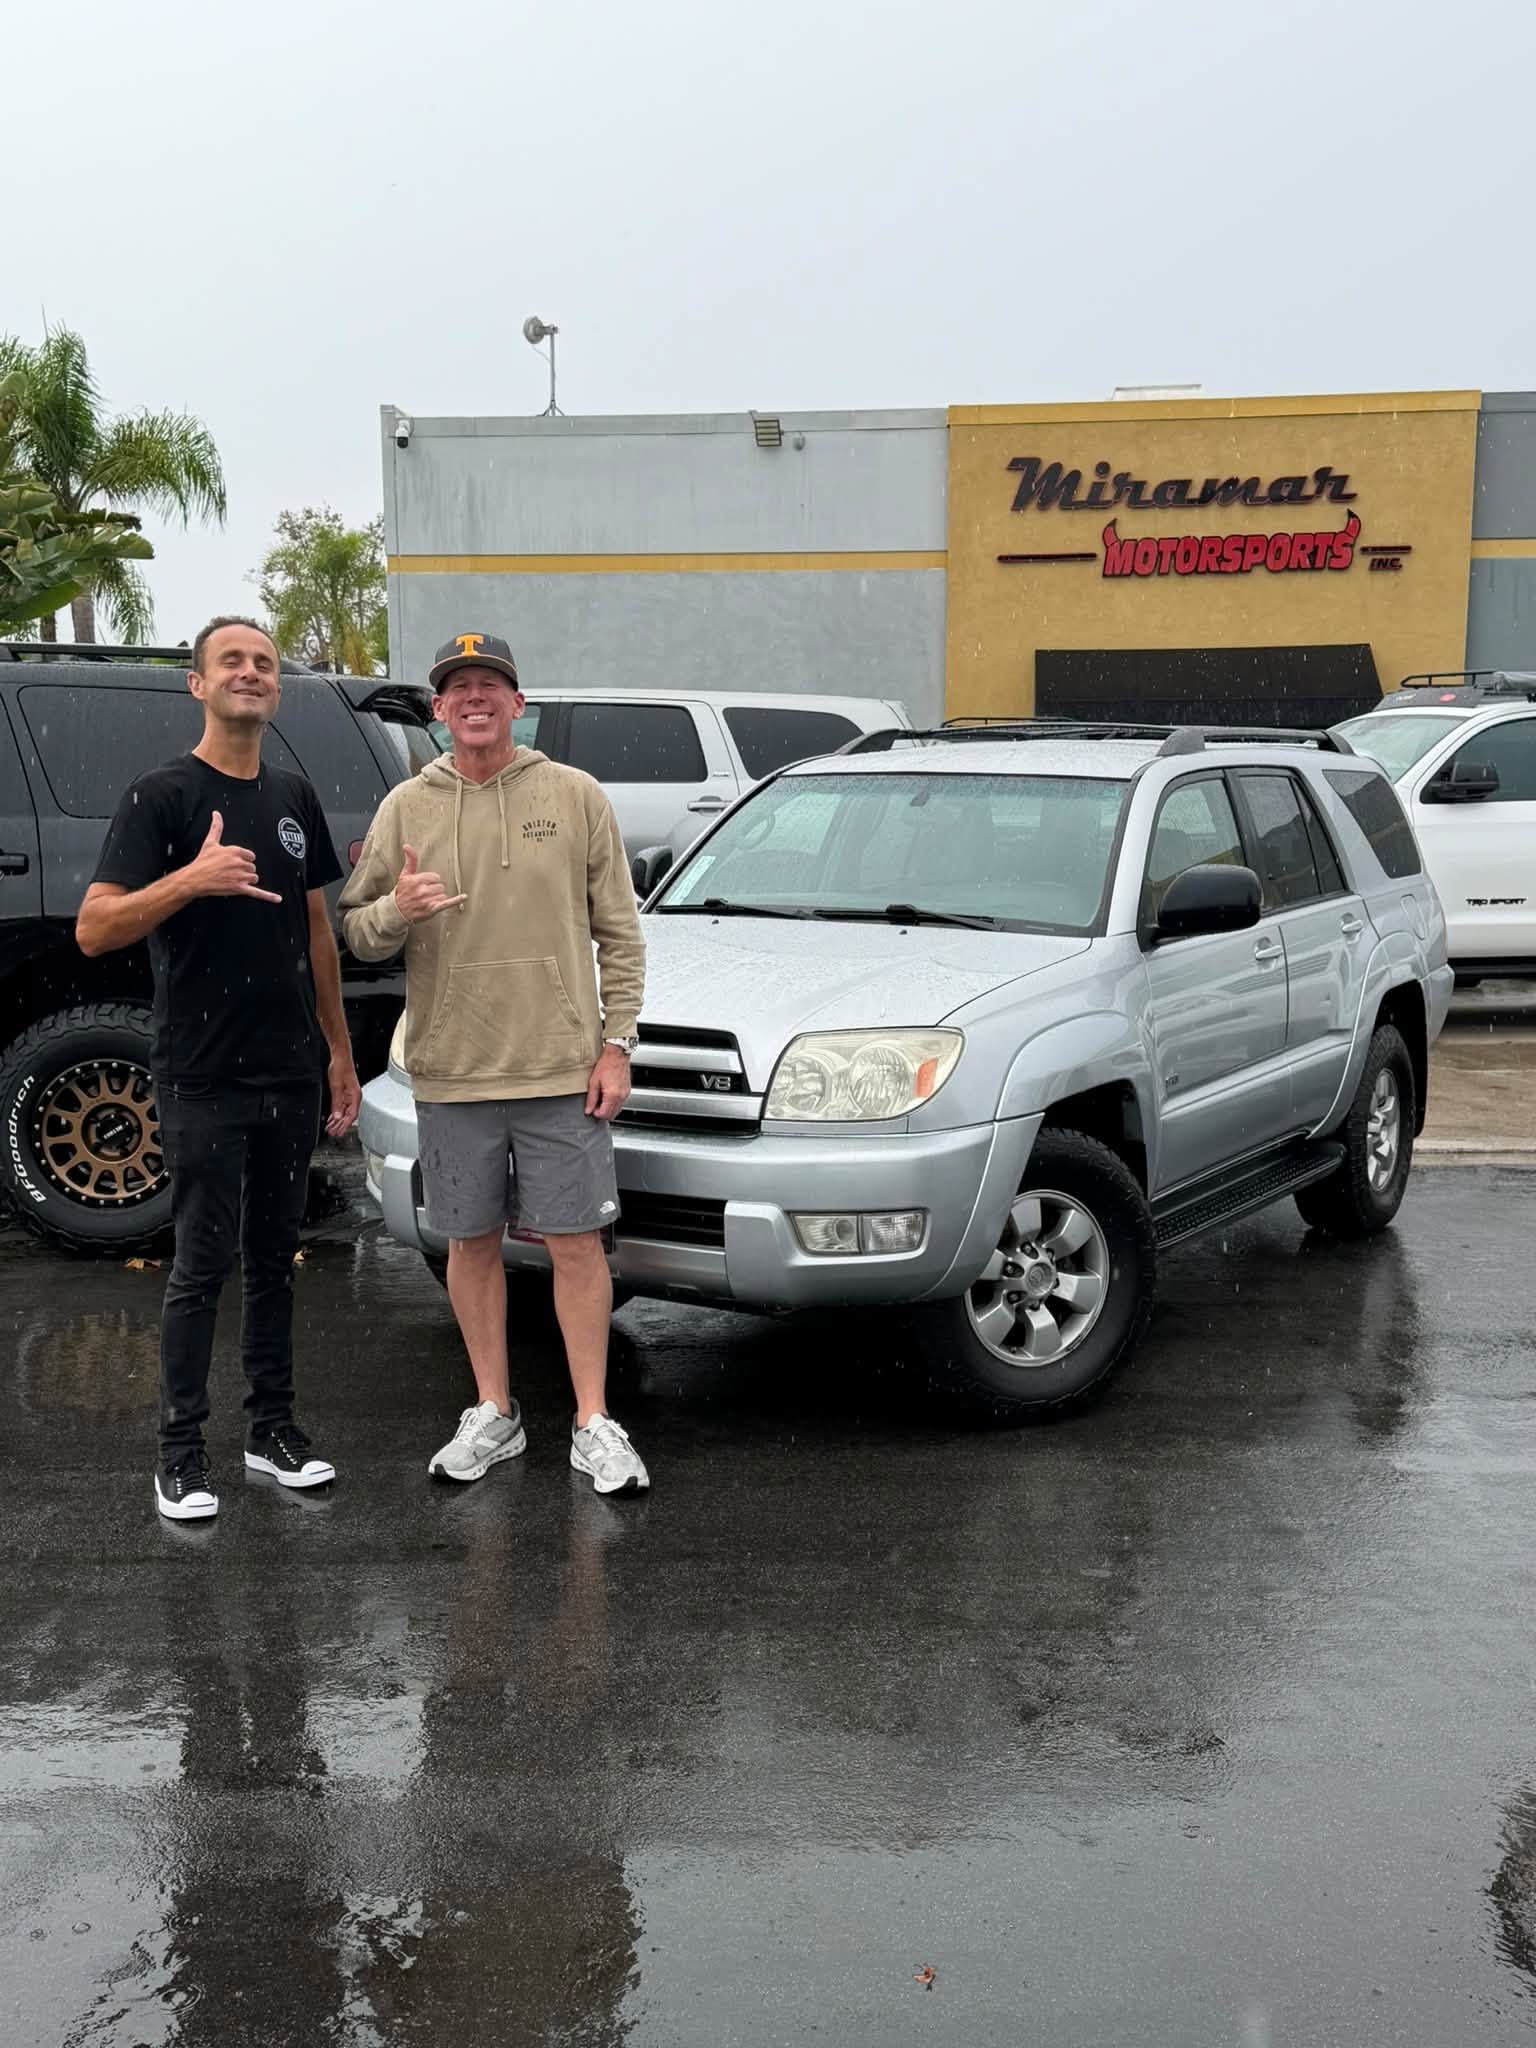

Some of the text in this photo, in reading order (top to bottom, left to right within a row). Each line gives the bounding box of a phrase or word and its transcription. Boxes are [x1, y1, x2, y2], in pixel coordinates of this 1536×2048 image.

[1006, 456, 1358, 511] Miramar
[1103, 526, 1358, 577] MOTORSPORTS
[1369, 557, 1403, 572] INC.
[456, 633, 484, 657] T
[700, 1073, 731, 1091] V8
[8, 1074, 47, 1203] BFGoodrich
